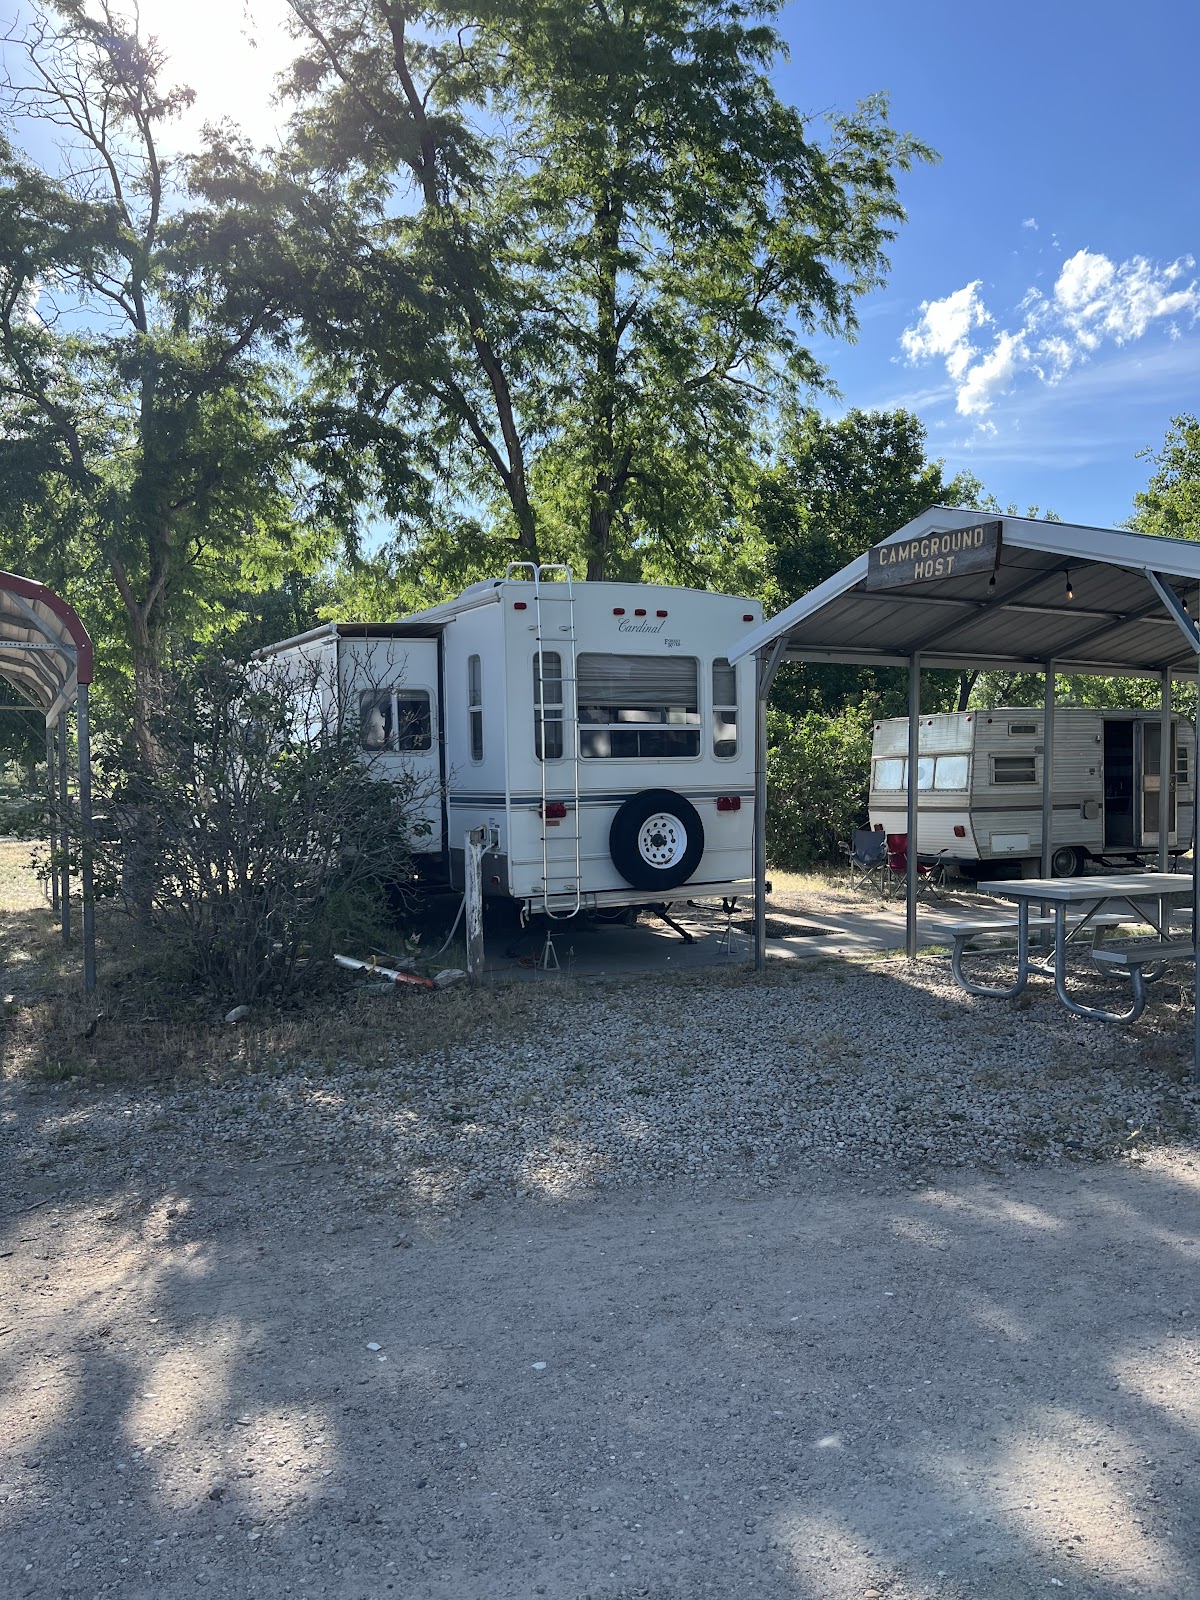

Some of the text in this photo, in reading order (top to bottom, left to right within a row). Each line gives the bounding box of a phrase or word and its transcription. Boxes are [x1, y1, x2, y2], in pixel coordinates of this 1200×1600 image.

[879, 528, 984, 566] CAMPGROUND
[914, 556, 955, 579] HOST
[618, 618, 666, 633] Cardinal
